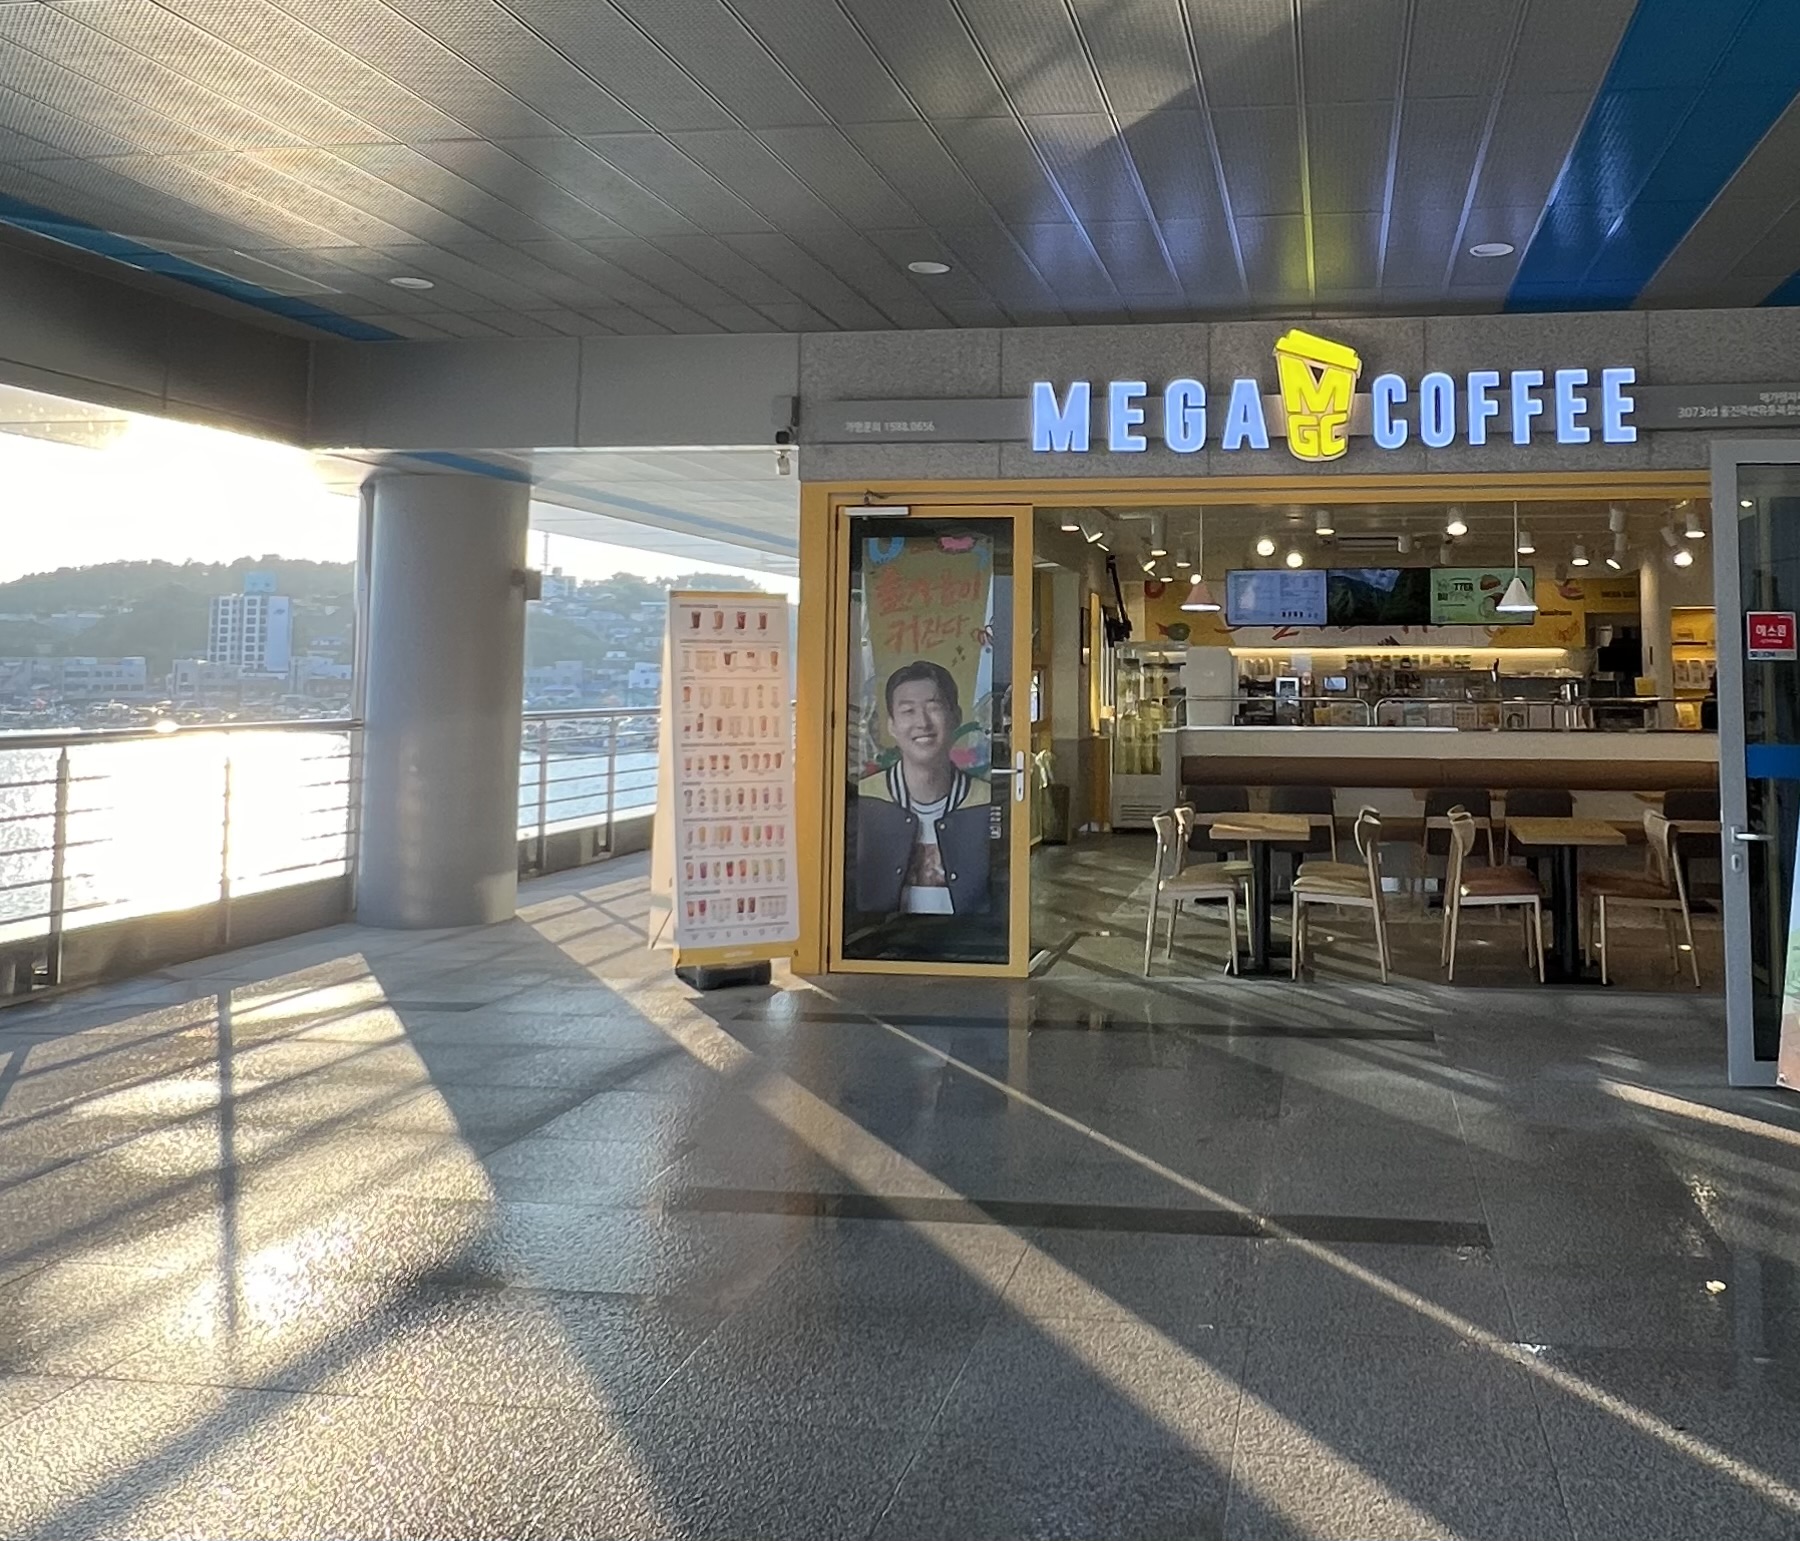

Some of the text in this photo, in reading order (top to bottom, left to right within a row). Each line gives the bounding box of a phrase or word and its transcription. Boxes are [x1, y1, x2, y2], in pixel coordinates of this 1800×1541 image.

[1031, 366, 1638, 454] MEGA COFFEE
[1755, 624, 1787, 637] 에스원
